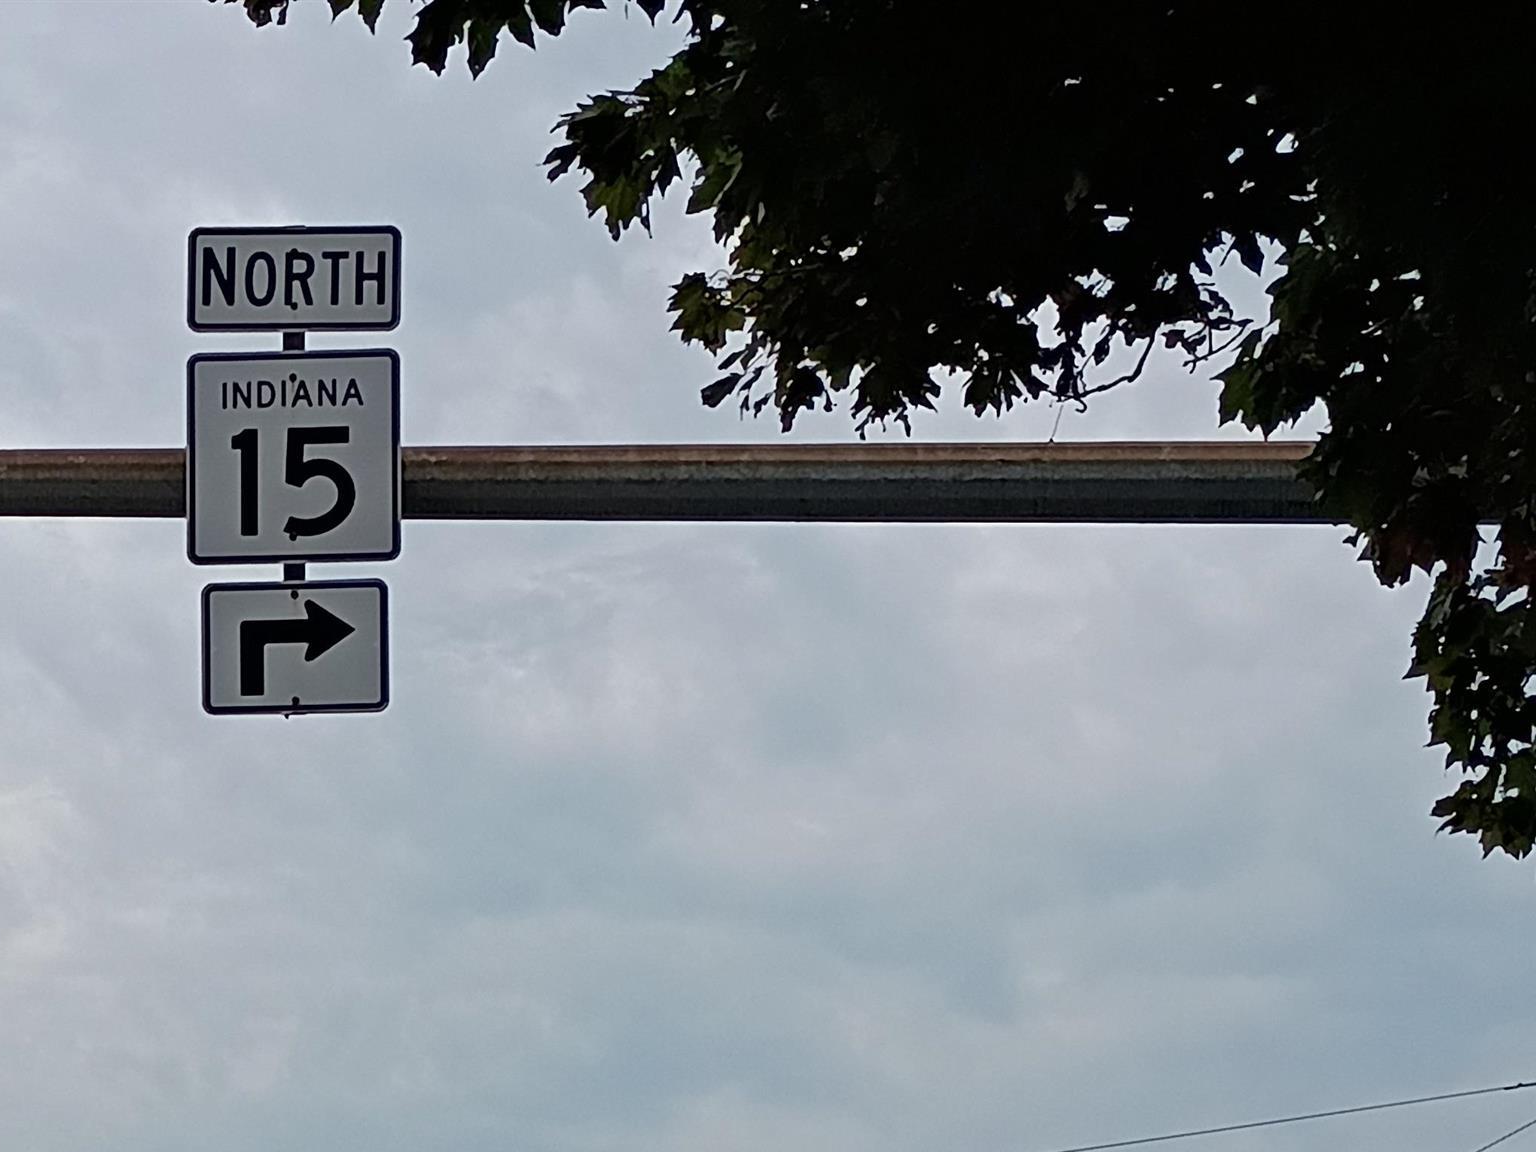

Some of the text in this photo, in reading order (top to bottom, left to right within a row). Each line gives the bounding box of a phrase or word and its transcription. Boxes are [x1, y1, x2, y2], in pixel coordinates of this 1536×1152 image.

[202, 246, 387, 307] NORTH
[222, 377, 365, 410] INDIANA
[230, 425, 357, 538] 15
